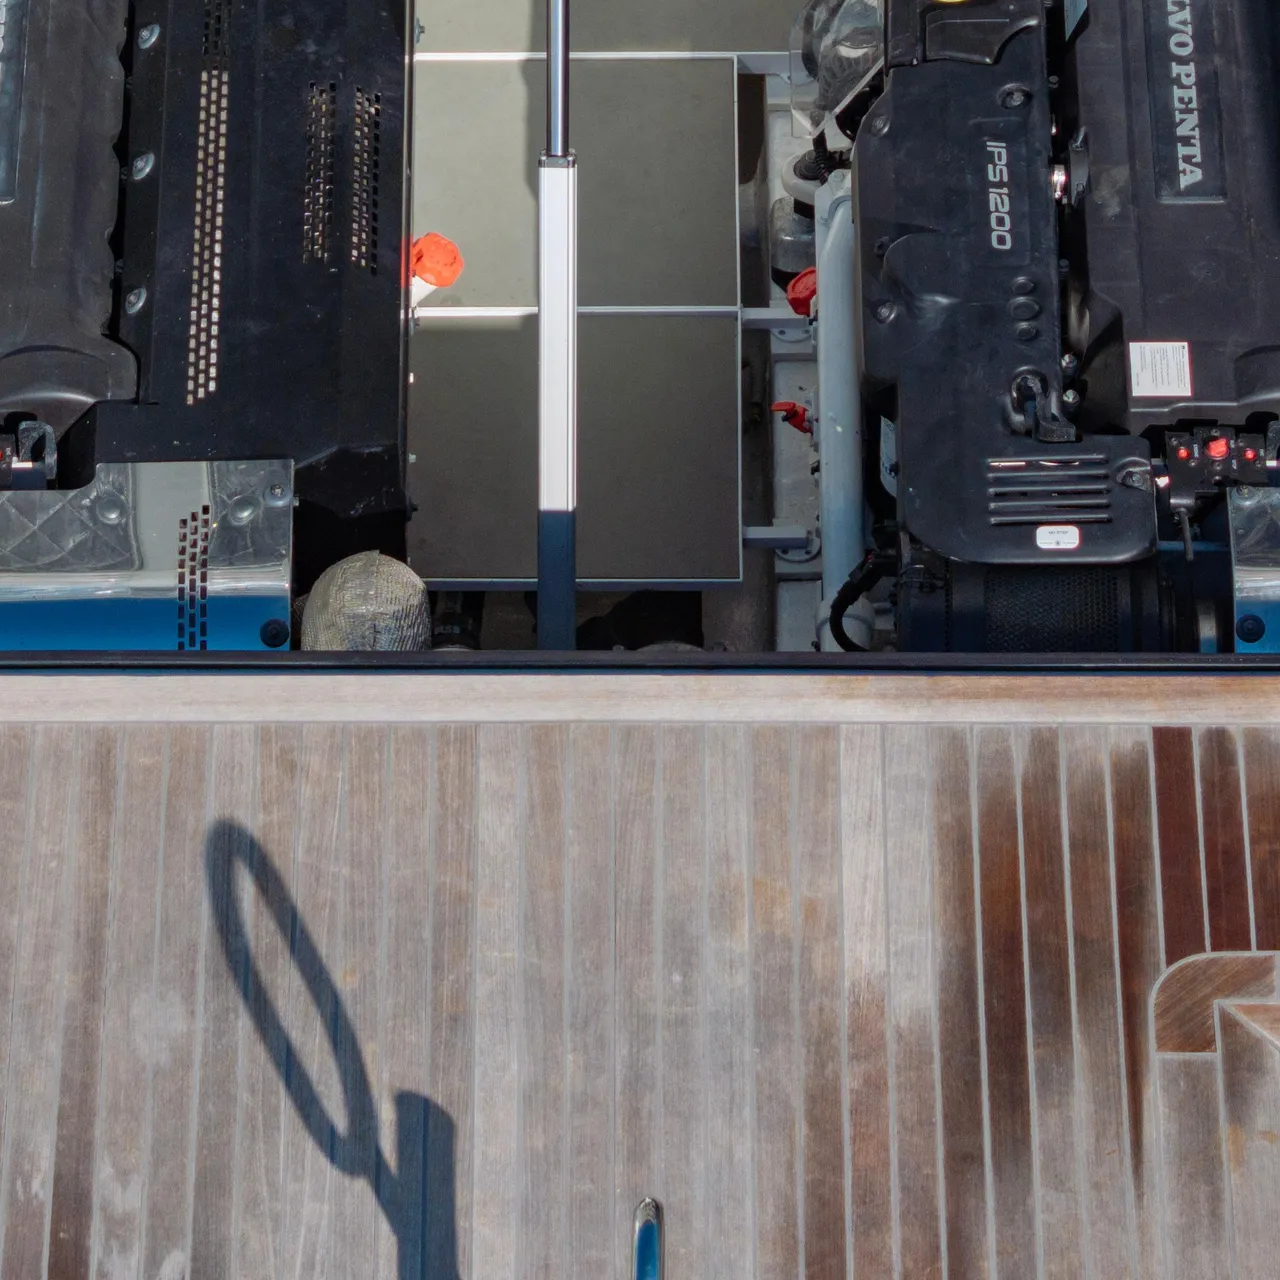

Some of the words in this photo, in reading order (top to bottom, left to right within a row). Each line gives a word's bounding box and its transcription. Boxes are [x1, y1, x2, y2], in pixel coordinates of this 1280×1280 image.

[1171, 61, 1204, 192] PENTA
[985, 141, 1009, 182] IPS
[988, 187, 1012, 250] 1200
